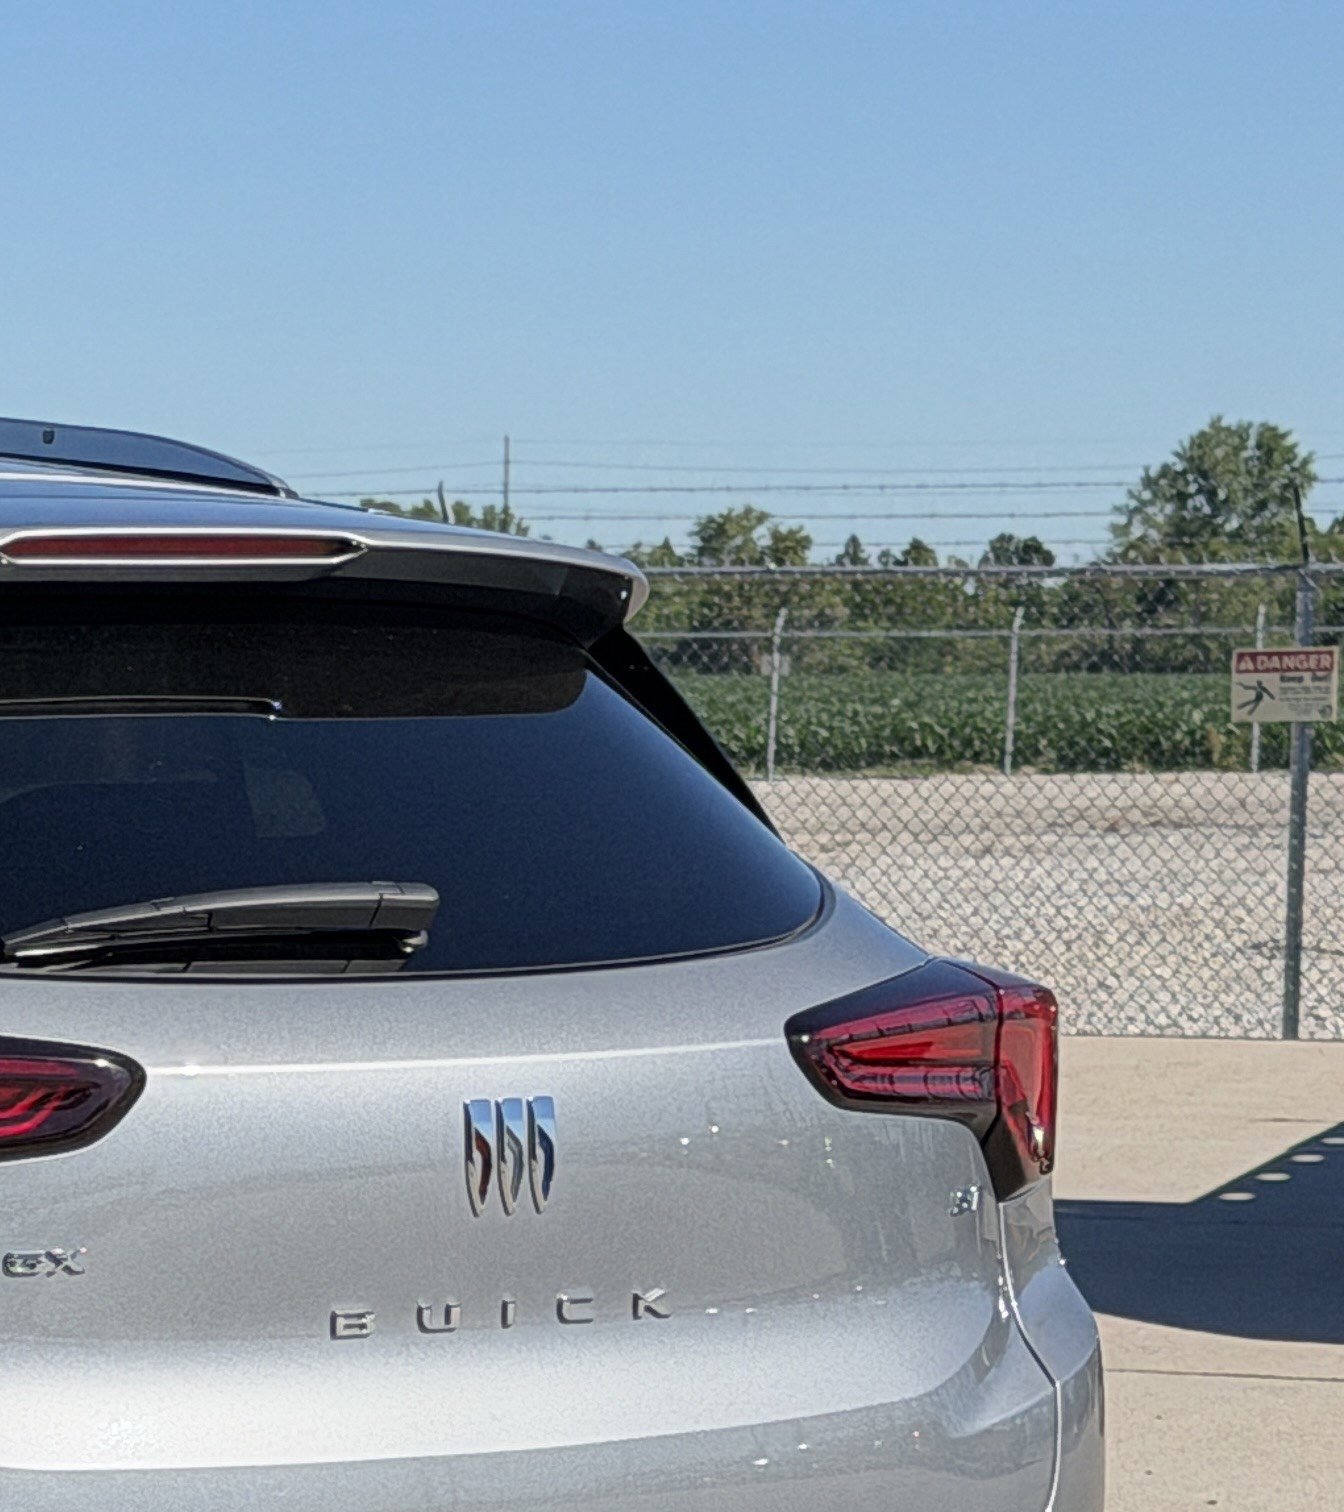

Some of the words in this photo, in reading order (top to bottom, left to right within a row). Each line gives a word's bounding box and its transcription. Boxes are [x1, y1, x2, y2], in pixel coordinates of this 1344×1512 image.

[1255, 653, 1332, 671] DANGER
[2, 1246, 86, 1277] GX
[329, 1288, 672, 1340] BUICK
